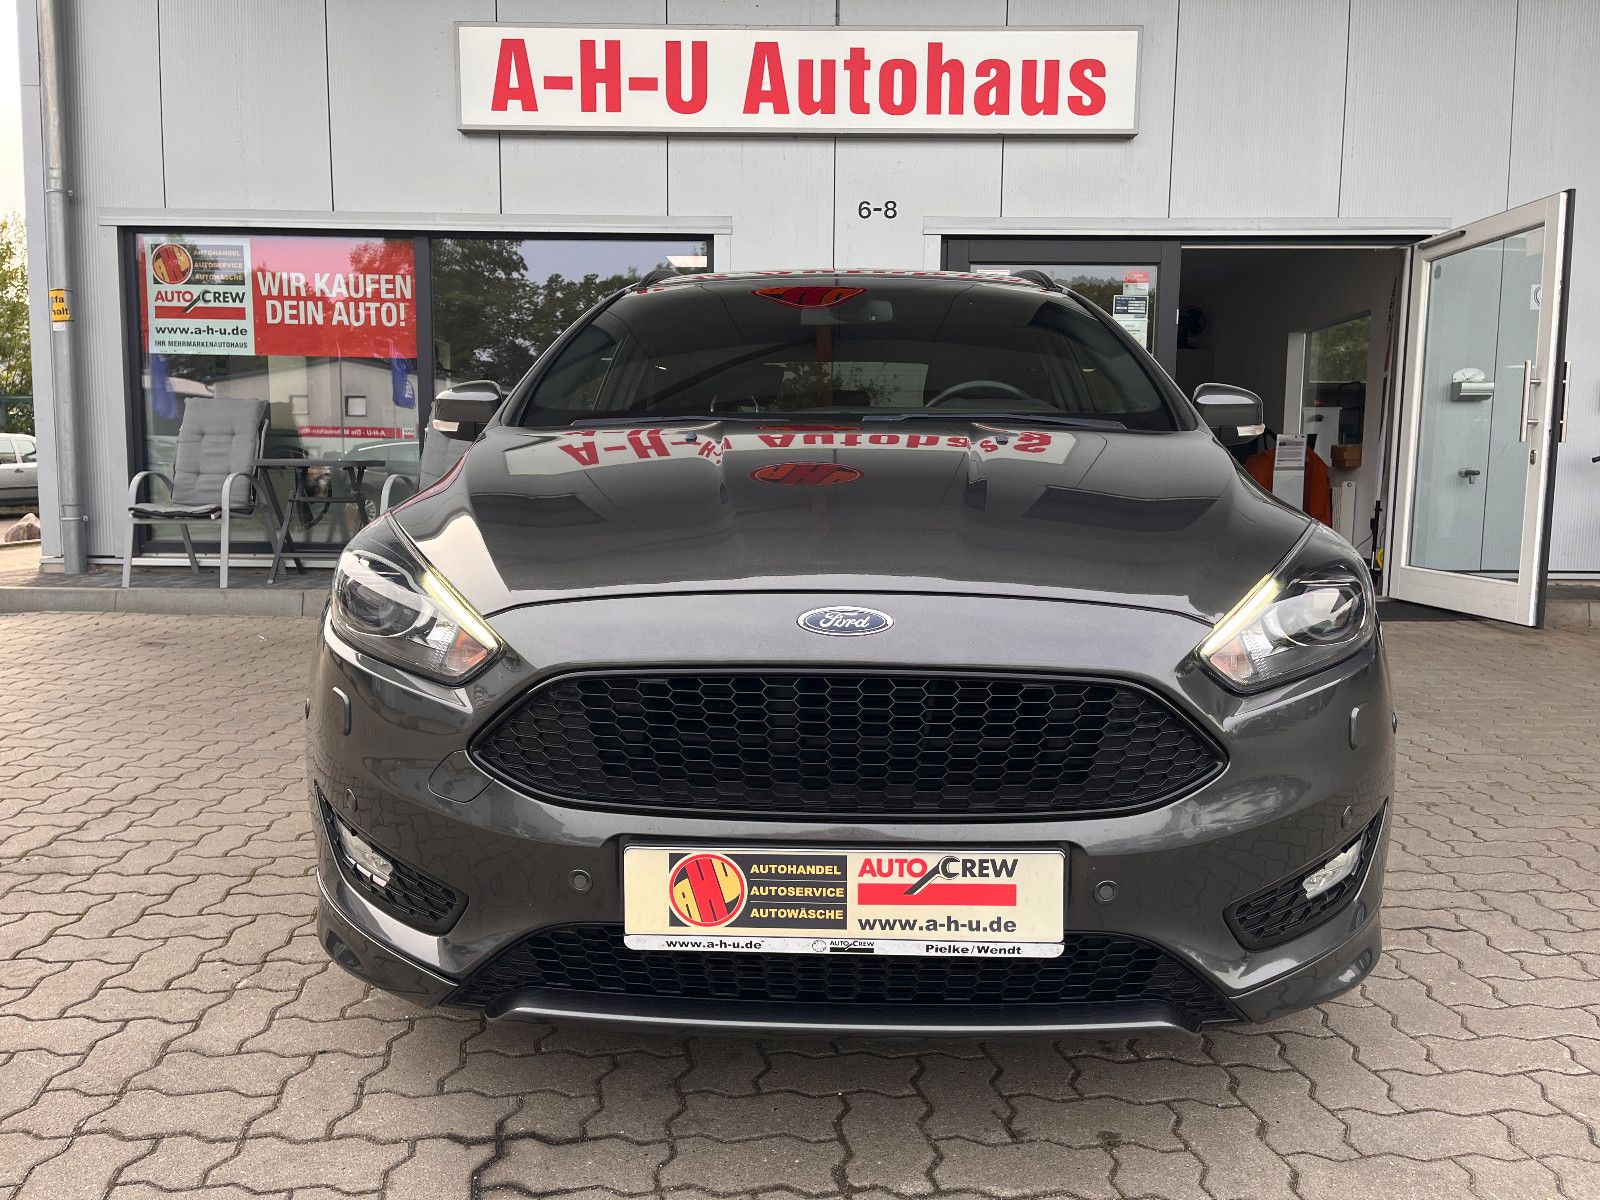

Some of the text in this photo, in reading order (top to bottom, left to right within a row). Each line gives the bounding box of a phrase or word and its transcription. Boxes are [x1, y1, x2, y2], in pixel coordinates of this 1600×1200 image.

[490, 38, 1107, 117] A-H-U Autohaus
[858, 200, 898, 219] 6-8
[193, 249, 241, 257] AUTOHANDEL
[194, 261, 243, 269] AUTOSERVICE
[256, 271, 412, 299] WIR KAUFEN
[265, 300, 406, 327] DEIN AUTO!
[155, 325, 248, 336] www.a-h-u.de
[167, 340, 248, 349] MEHRMARKENAUTOHAUS
[819, 611, 871, 628] Ford
[750, 864, 842, 876] AUTOHANDEL
[750, 886, 845, 898] AUTOSERVICE
[750, 907, 844, 920] AUTOWÄSCHE
[857, 916, 1017, 933] www.a-h-u.de
[666, 939, 762, 950] www.a-h-u.de
